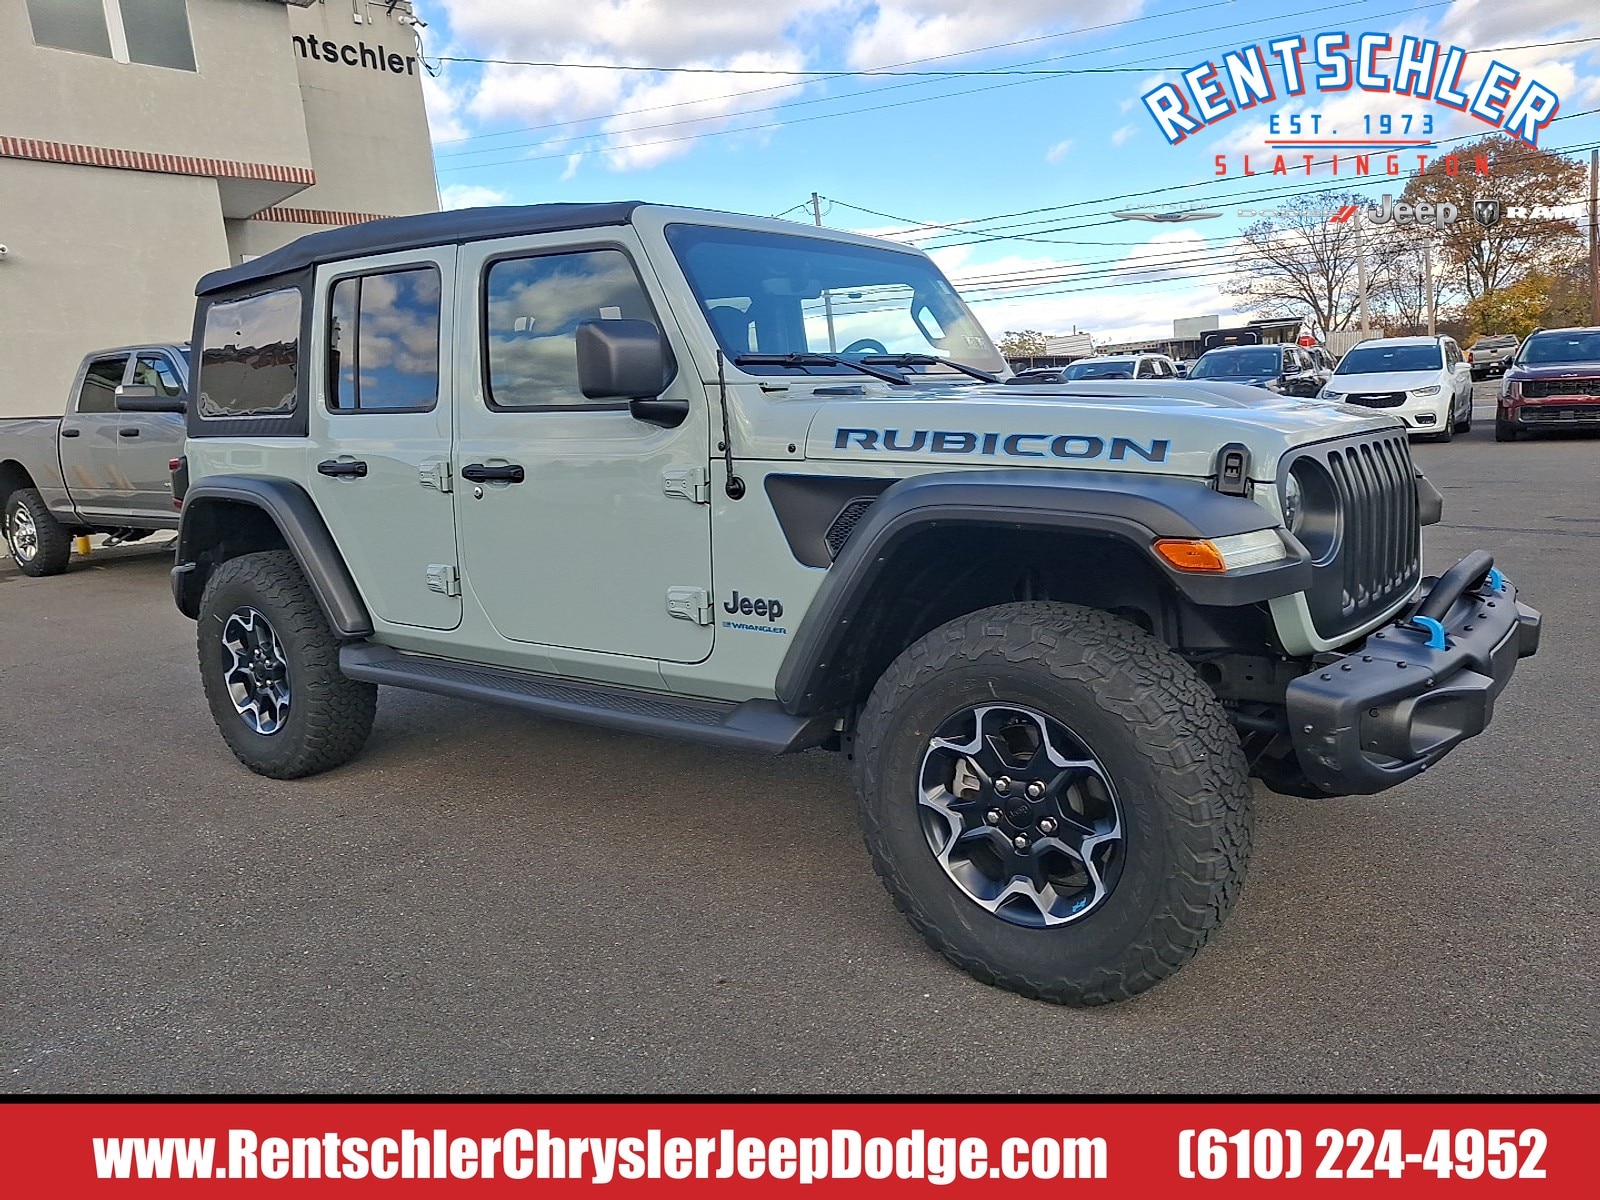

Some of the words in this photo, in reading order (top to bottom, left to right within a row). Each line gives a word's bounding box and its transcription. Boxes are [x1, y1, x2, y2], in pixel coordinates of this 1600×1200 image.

[834, 427, 1172, 464] RUBICON
[723, 590, 784, 622] Jeep
[731, 622, 787, 635] WRANGLER
